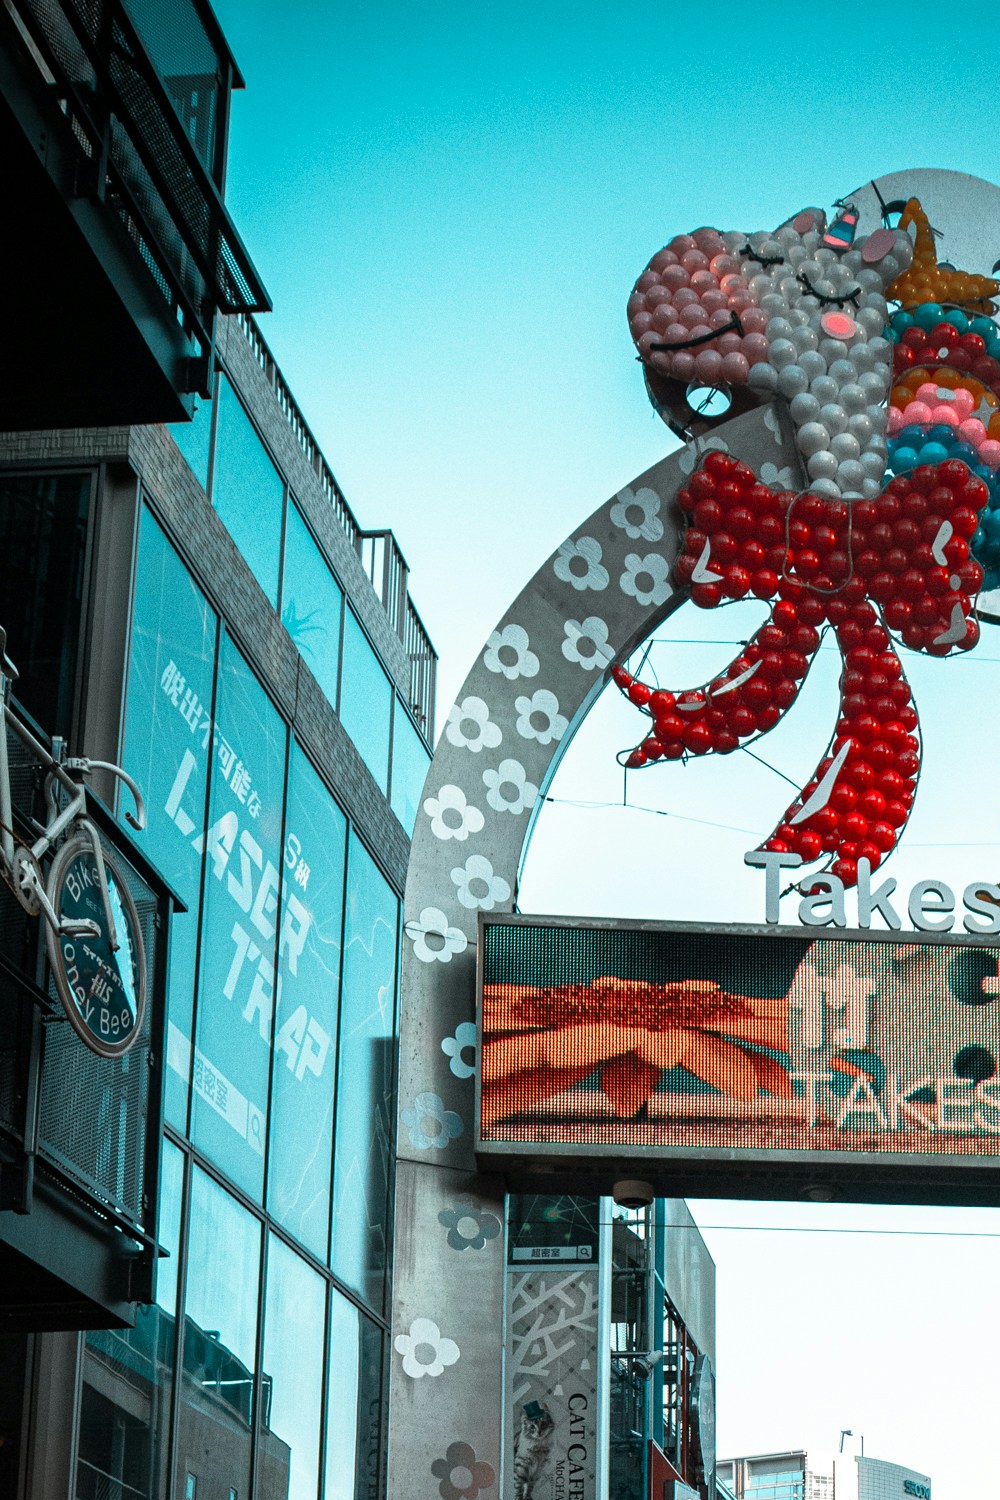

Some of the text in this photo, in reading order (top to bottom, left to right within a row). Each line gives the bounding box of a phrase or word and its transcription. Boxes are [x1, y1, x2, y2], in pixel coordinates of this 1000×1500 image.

[160, 659, 261, 818] 脱出不可能な
[66, 861, 101, 903] Bike
[164, 748, 314, 978] LASER
[100, 1007, 131, 1035] Bee
[222, 921, 331, 1082] TRAP
[567, 1393, 588, 1440] CAT
